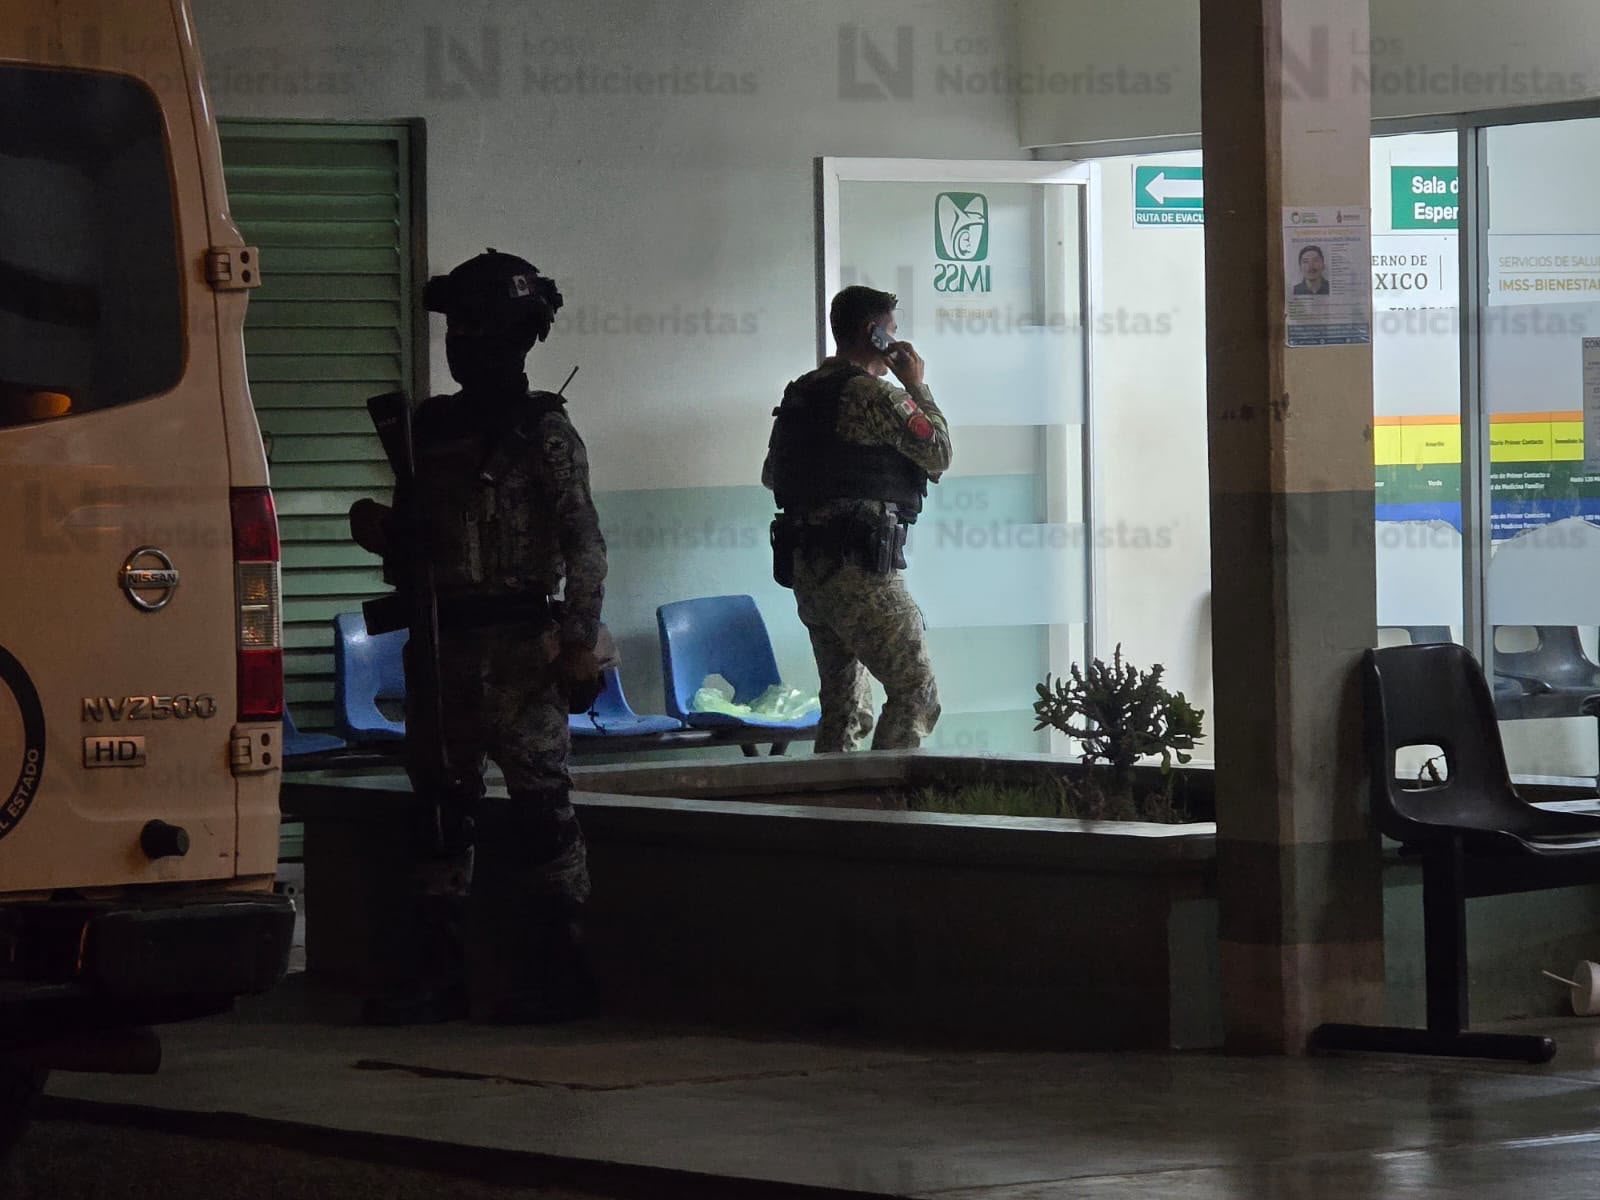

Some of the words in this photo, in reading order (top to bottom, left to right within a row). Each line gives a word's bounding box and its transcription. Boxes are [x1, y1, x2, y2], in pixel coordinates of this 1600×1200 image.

[1411, 175, 1446, 194] Sala
[1136, 213, 1160, 222] RUTA
[1161, 213, 1174, 222] DE
[1411, 255, 1428, 266] DE
[1499, 256, 1552, 267] SERVICIOS
[1555, 255, 1569, 266] DE
[1571, 255, 1600, 266] SALU
[1375, 273, 1428, 290] XICO
[127, 572, 176, 584] NISSAN
[82, 694, 217, 722] NV2500
[96, 741, 137, 762] HD
[7, 749, 39, 817] ESTADO
